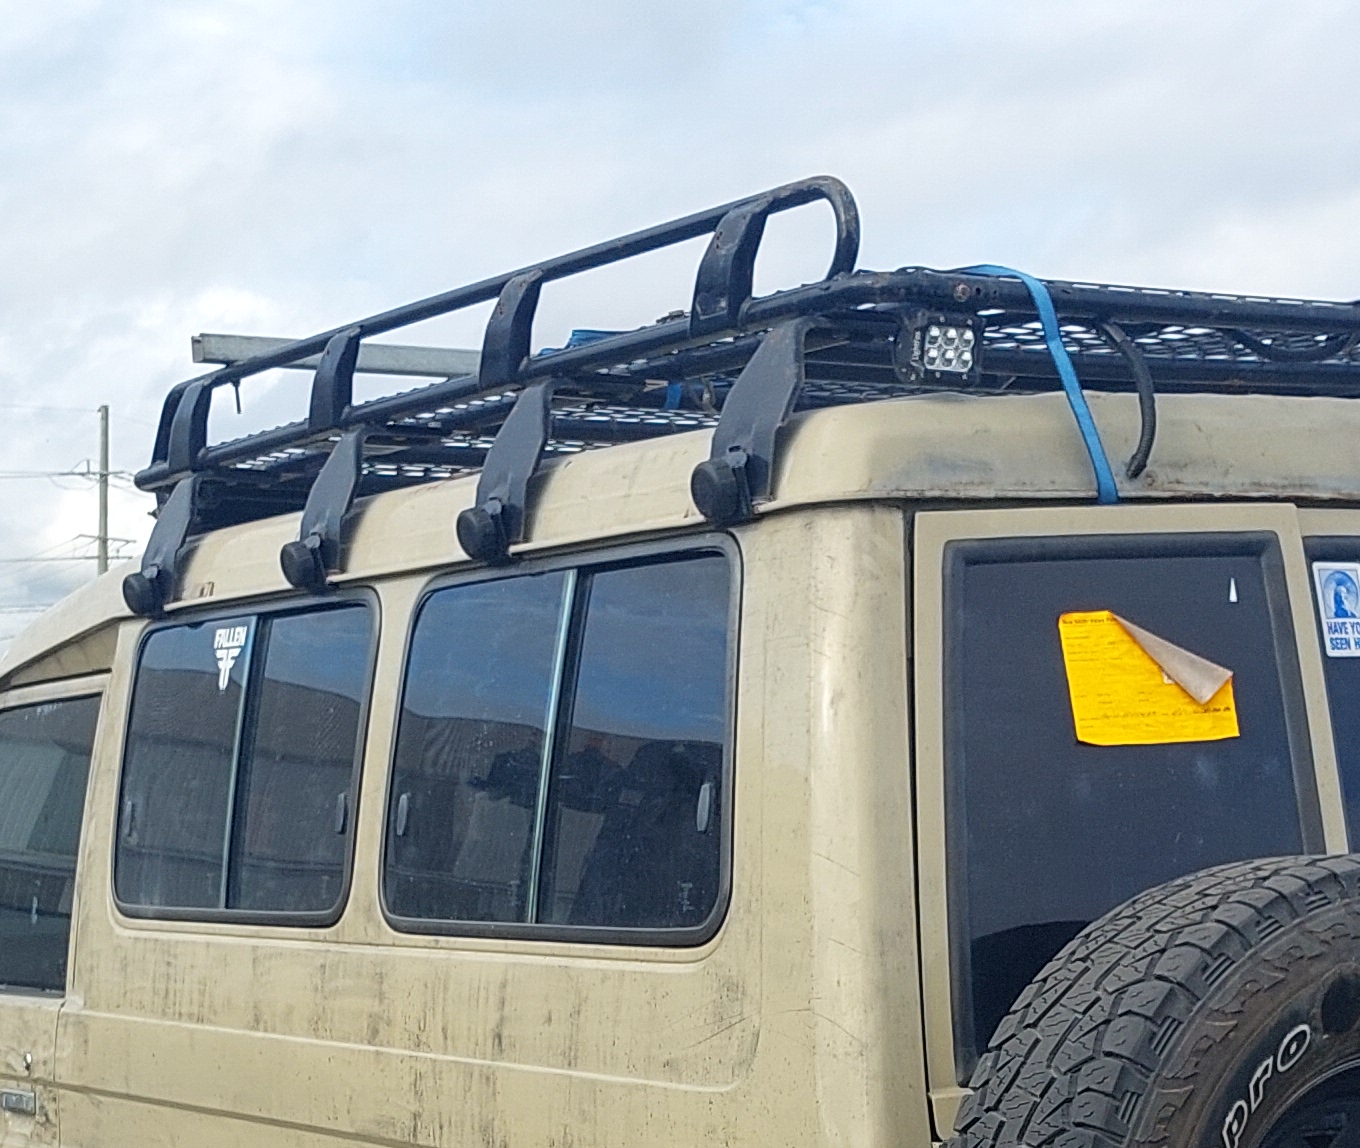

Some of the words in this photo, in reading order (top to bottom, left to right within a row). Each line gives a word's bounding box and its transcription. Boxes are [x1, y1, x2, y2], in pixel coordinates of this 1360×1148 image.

[1326, 621, 1349, 635] HAVE
[213, 626, 248, 650] FALLEN
[1329, 637, 1351, 650] SEEN
